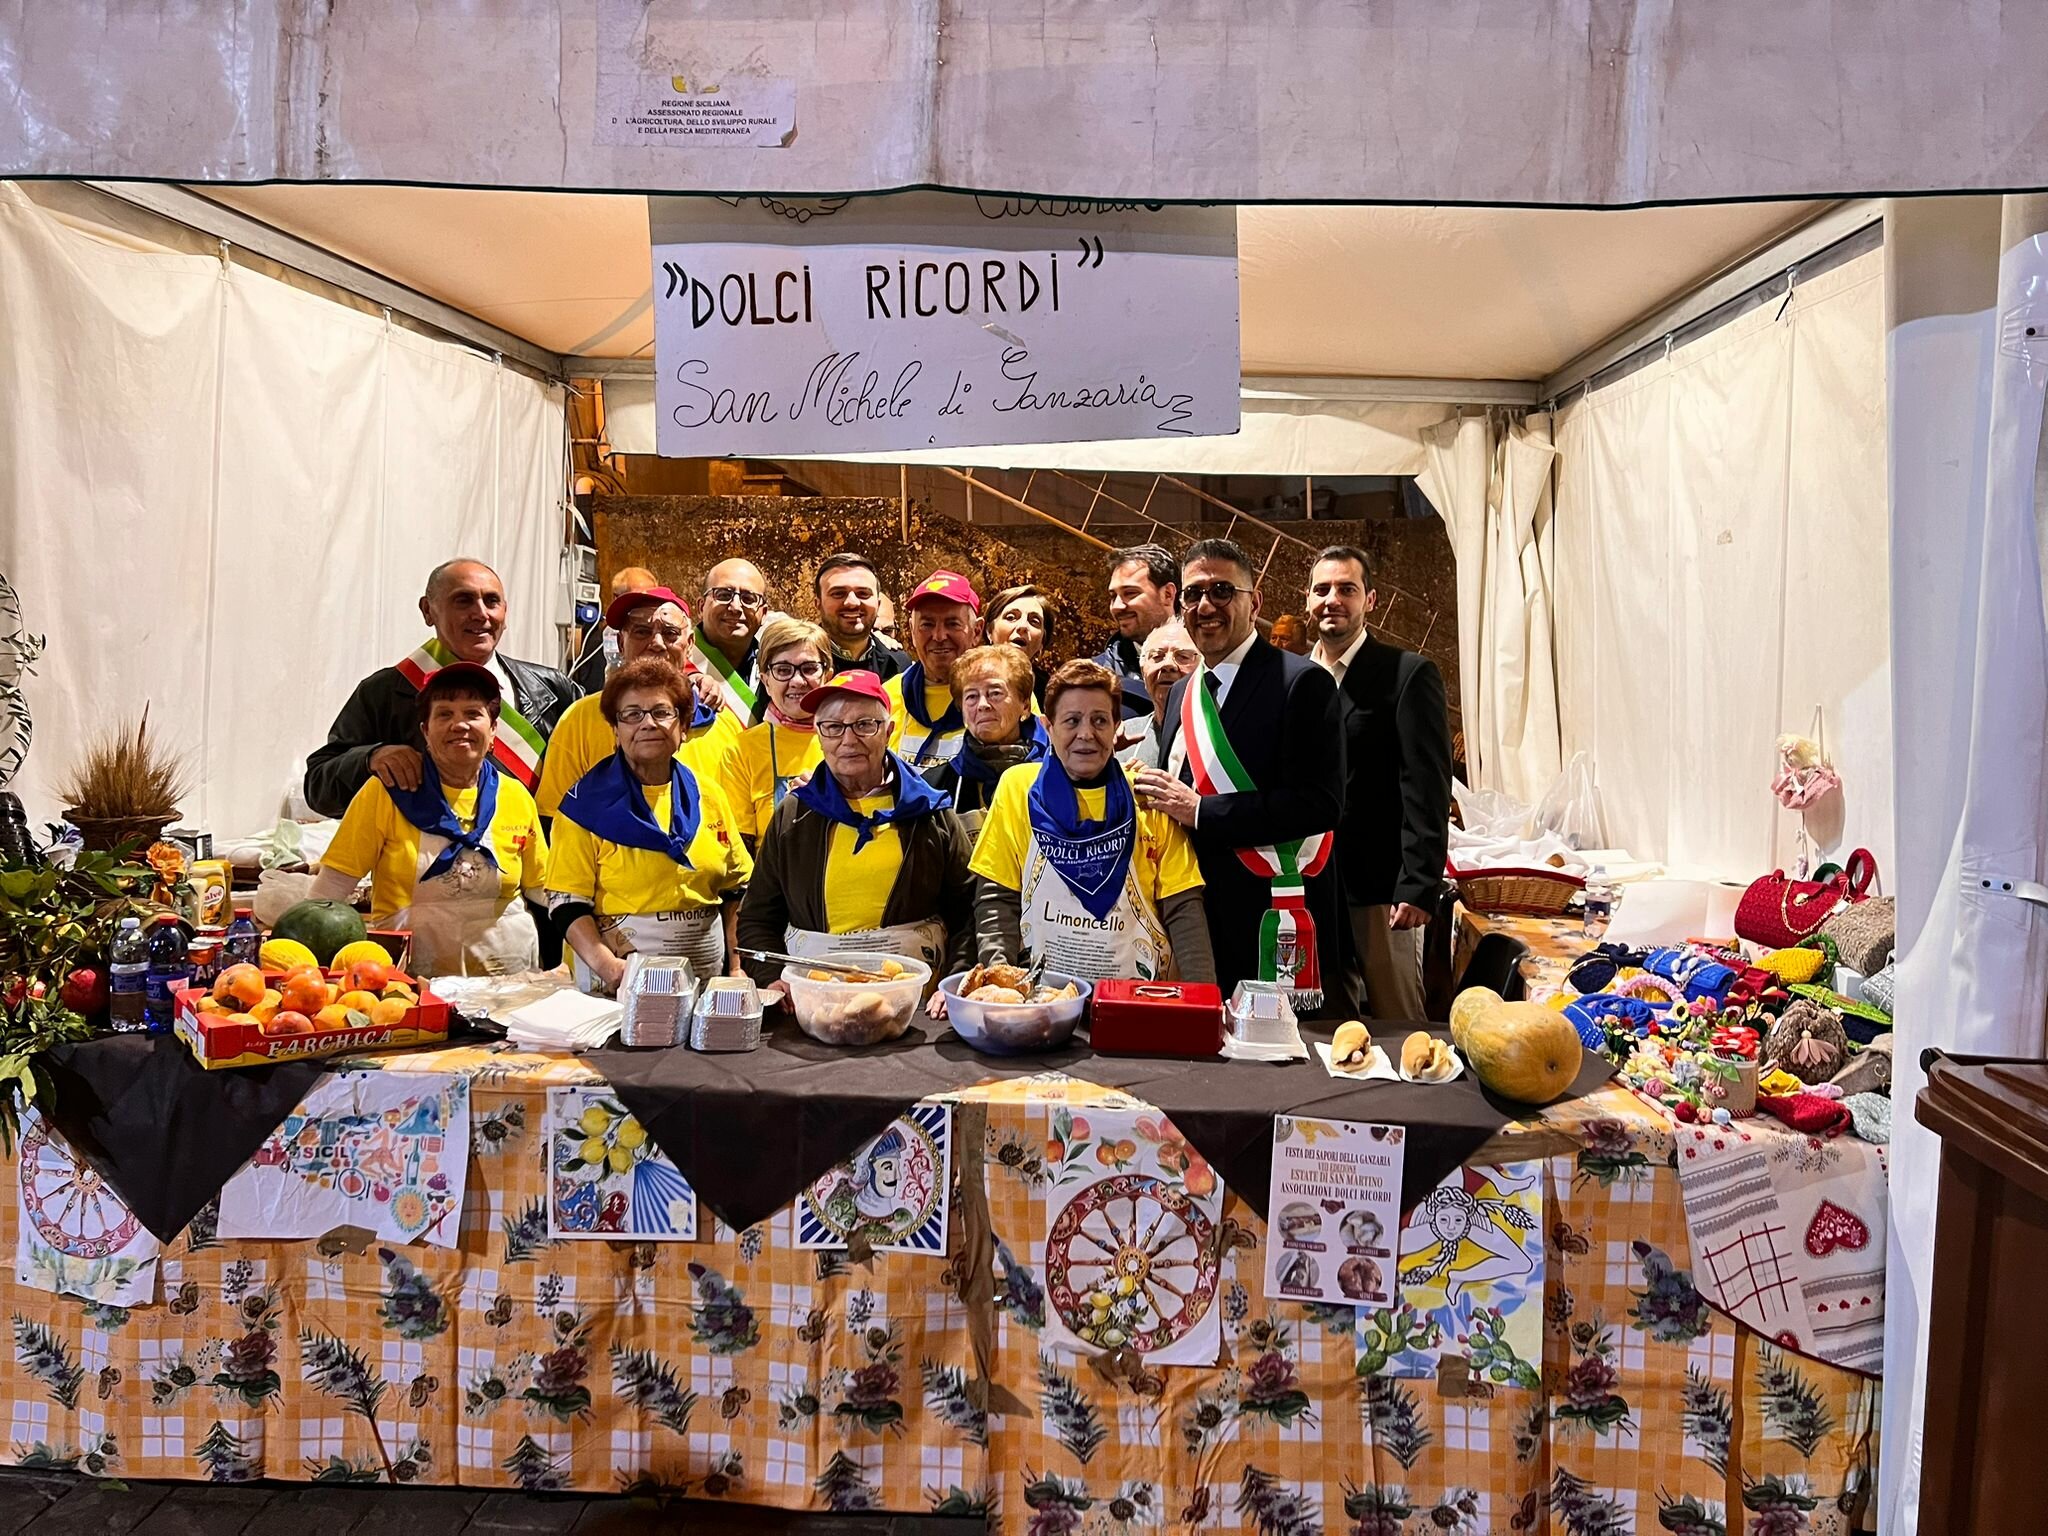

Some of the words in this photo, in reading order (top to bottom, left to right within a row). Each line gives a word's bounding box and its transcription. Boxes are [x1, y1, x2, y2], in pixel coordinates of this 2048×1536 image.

[669, 127, 694, 135] PESCA
[695, 127, 751, 135] MEDITERRANEA
[686, 118, 710, 126] DELLO
[711, 118, 747, 126] SVILUPPO
[748, 117, 777, 125] RURALE
[674, 359, 778, 428] San
[789, 352, 923, 426] Michele
[938, 370, 972, 418] di
[205, 890, 223, 902] alvé
[1043, 901, 1125, 932] Limoncello
[266, 1029, 394, 1057] FARCHICA
[303, 1146, 358, 1159] SICILY
[1285, 1146, 1304, 1159] FESTA
[1304, 1148, 1316, 1160] DEI
[1316, 1149, 1339, 1162] SAPORI
[1339, 1151, 1359, 1164] DELLA
[1359, 1153, 1391, 1167] GANZARIA
[1290, 1168, 1319, 1182] ESTATE
[1319, 1170, 1329, 1183] DI
[1329, 1172, 1345, 1185] SAN
[1346, 1173, 1383, 1188] MARTINO
[1280, 1181, 1333, 1198] ASSOCIAZIONE
[1334, 1187, 1358, 1200] DOLCI
[1360, 1189, 1392, 1203] RICORDI
